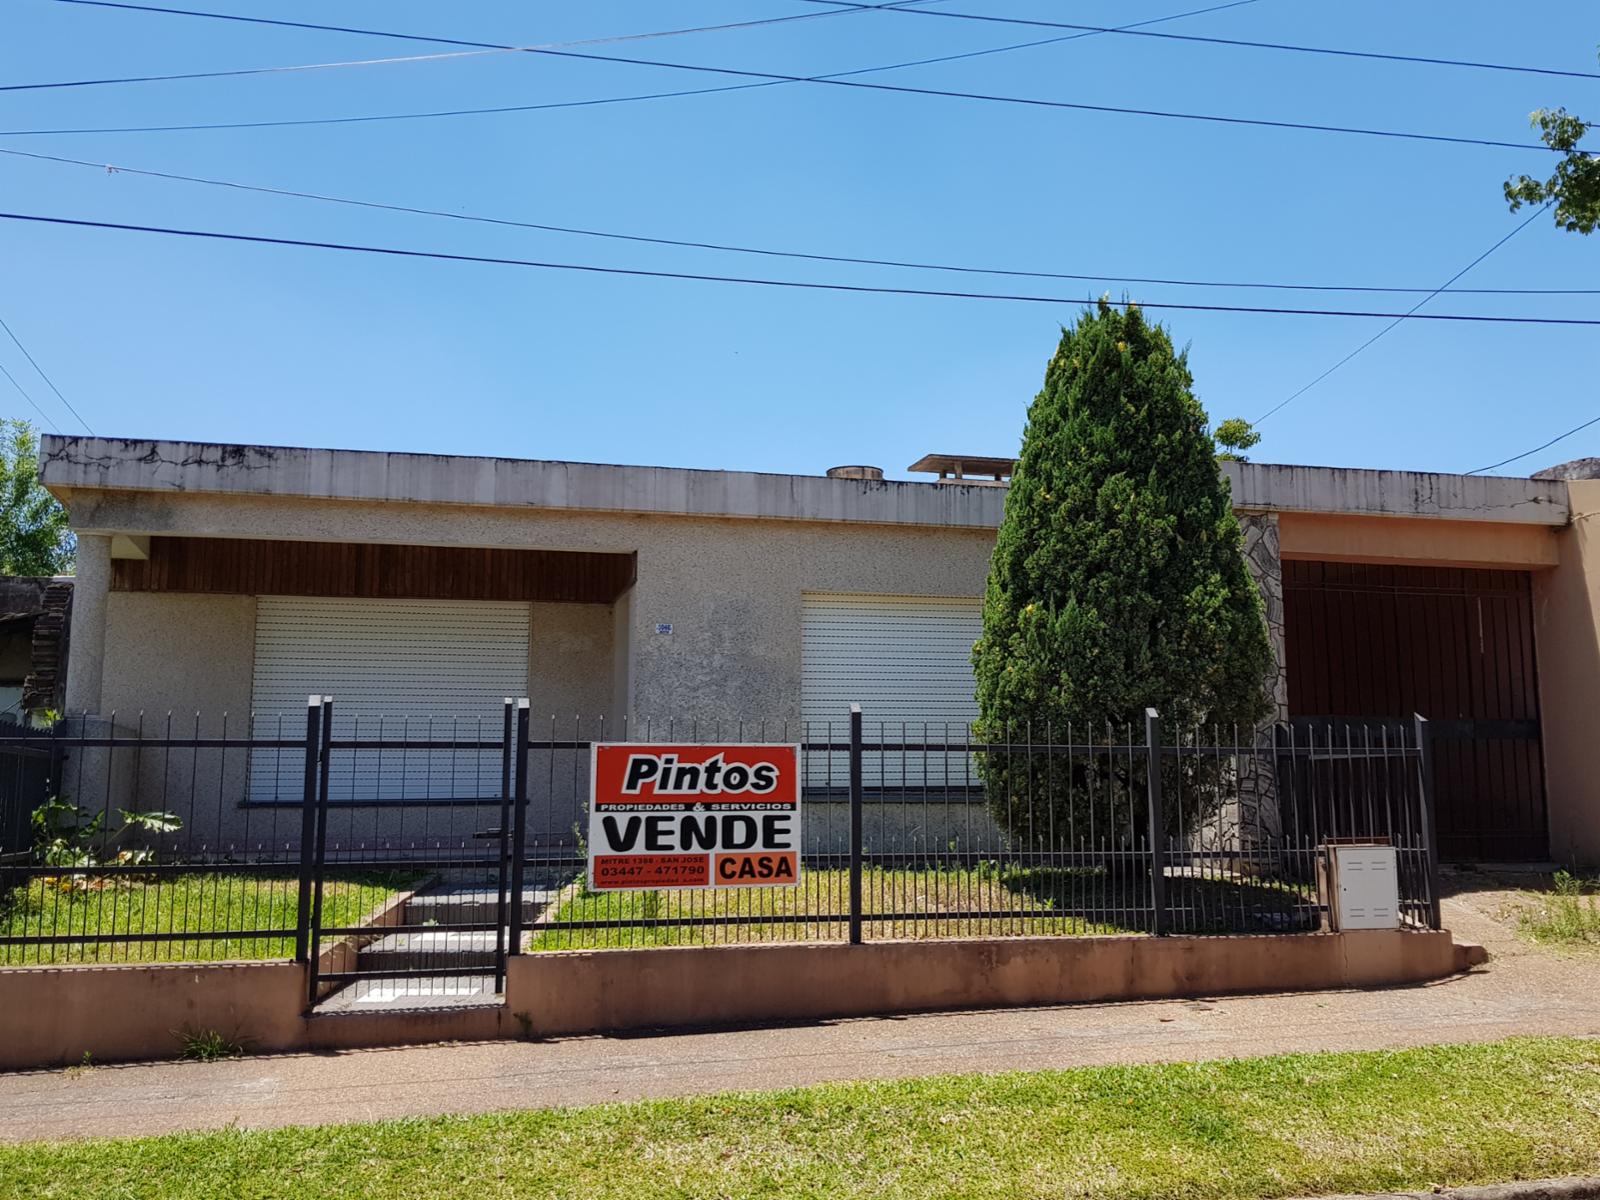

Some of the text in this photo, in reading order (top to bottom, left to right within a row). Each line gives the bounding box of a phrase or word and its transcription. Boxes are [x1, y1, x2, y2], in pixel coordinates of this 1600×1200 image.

[622, 753, 779, 794] Pintos
[601, 803, 685, 811] PROPIEDADES
[693, 802, 705, 811] &
[602, 814, 791, 852] VENDE
[601, 866, 643, 876] 03447
[655, 865, 704, 875] 471790
[719, 856, 793, 879] CASA
